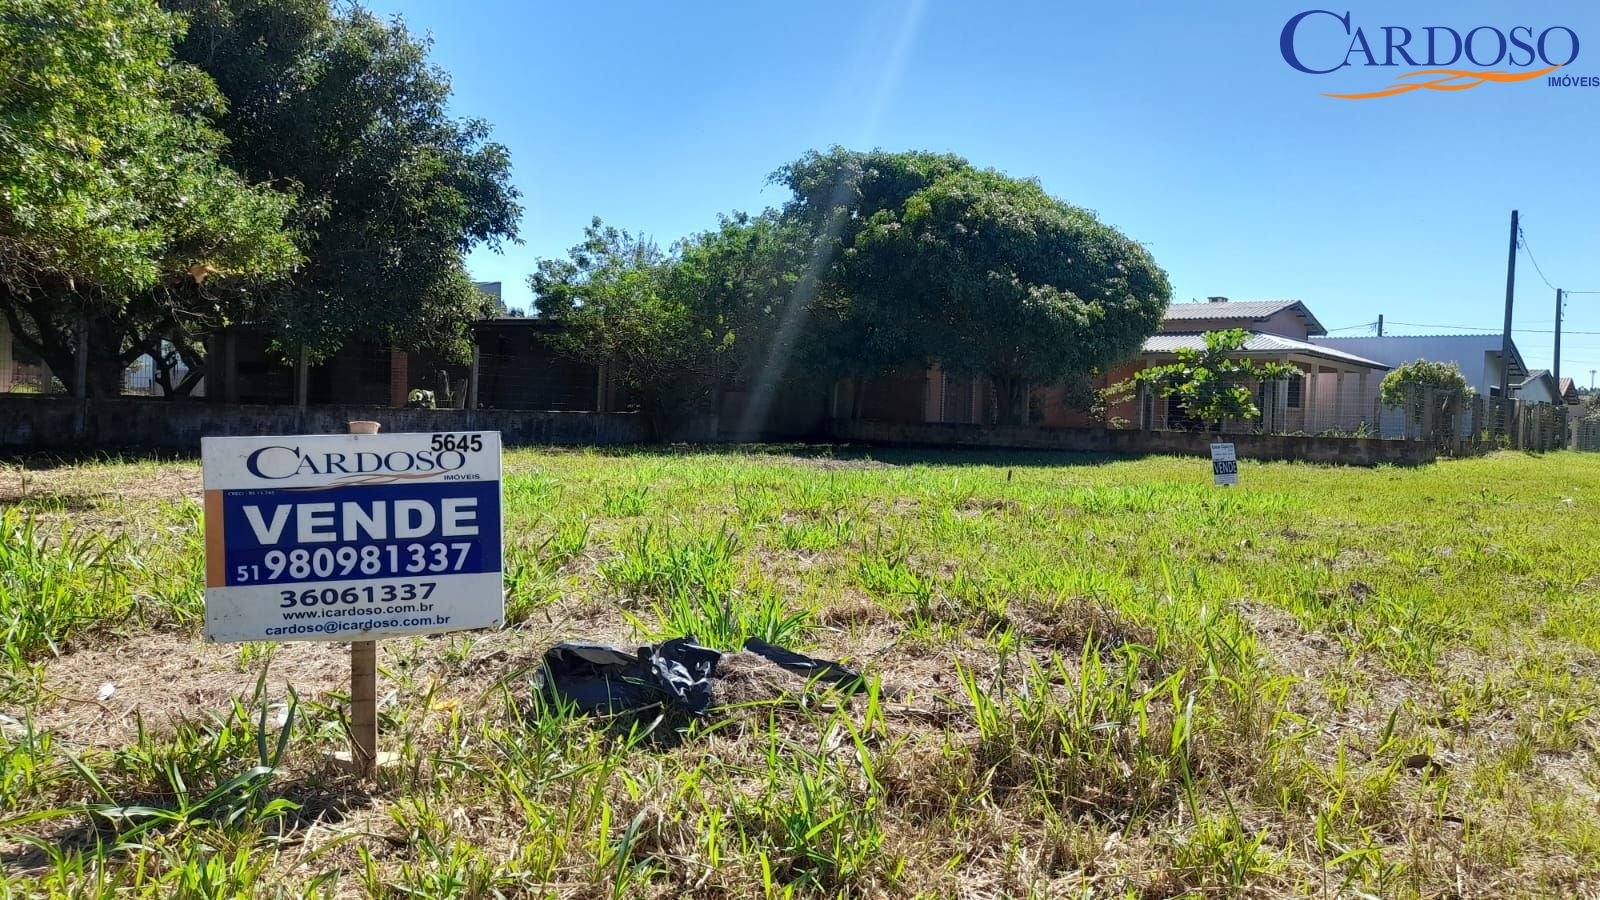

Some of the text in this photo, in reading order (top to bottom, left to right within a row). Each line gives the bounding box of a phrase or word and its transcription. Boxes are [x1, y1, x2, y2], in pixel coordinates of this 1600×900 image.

[431, 434, 482, 452] 5645
[246, 446, 466, 479] CARDOSO
[1214, 462, 1237, 473] VENDE
[443, 473, 481, 481] IMÓVEIS
[242, 497, 480, 545] VENDE
[237, 543, 472, 582] 51 980981337
[280, 582, 437, 608] 36061337
[282, 602, 434, 620] www.icardoso.com.br
[265, 614, 451, 636] cardoso@icardoso.com.br
